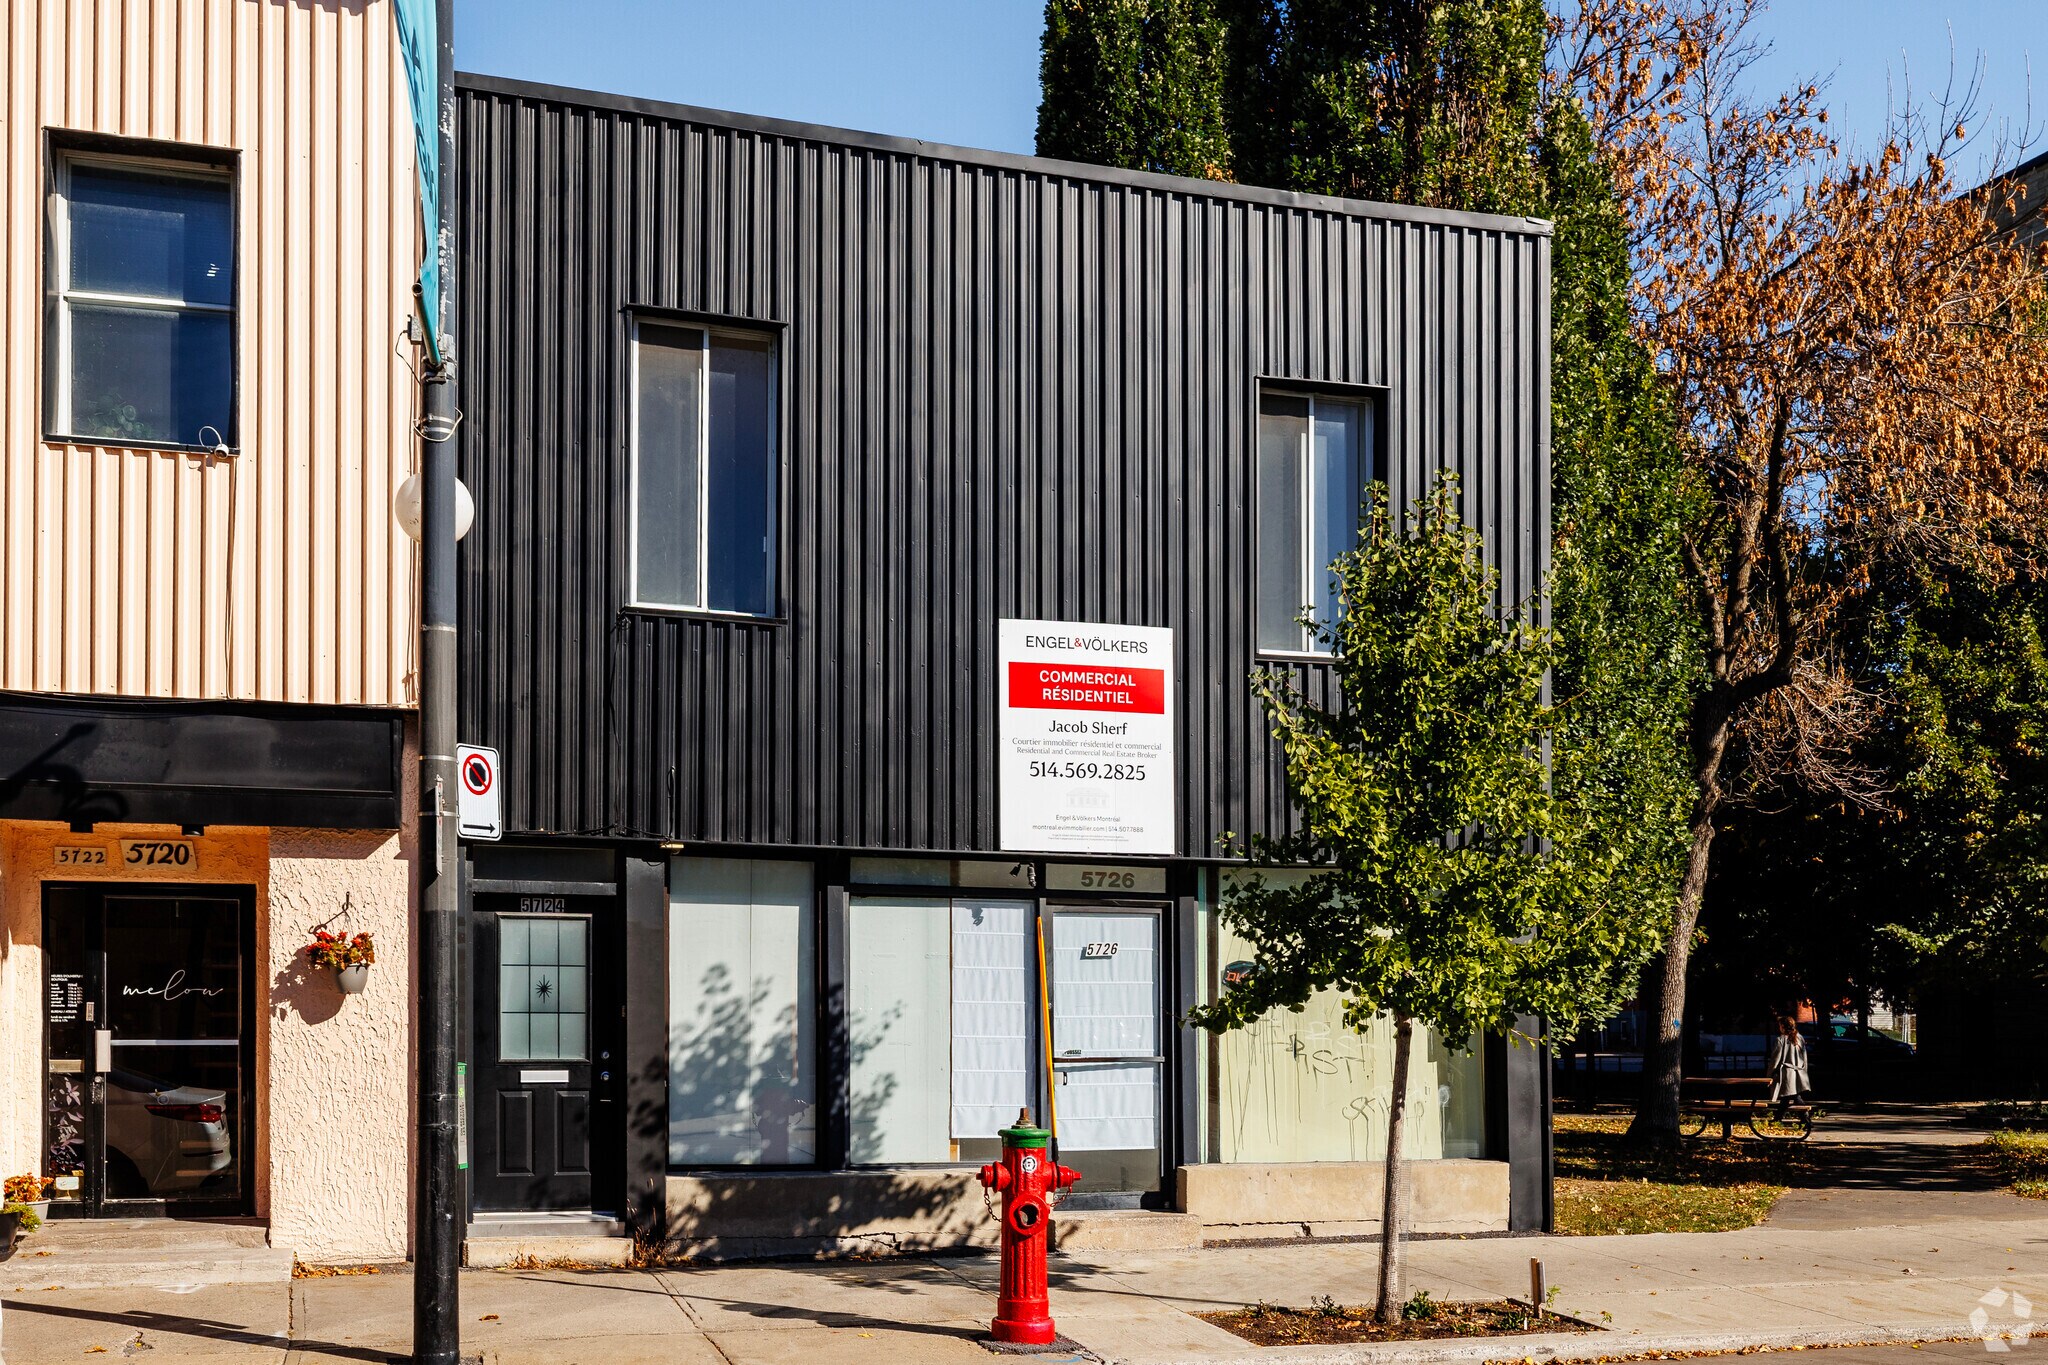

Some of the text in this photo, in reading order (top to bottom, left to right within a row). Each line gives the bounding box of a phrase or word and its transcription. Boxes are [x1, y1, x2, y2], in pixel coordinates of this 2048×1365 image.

[1039, 670, 1136, 687] COMMERCIAL
[1042, 685, 1133, 704] RÉSIDENTIEL
[1048, 720, 1128, 735] Jacob Sherf
[1012, 737, 1041, 746] Courtier
[1043, 738, 1079, 748] immobilier
[1080, 740, 1114, 749] résidentiel
[1124, 743, 1162, 751] commercial
[1016, 746, 1051, 755] Residential
[1064, 748, 1101, 757] Commercial
[1116, 750, 1136, 758] Estate
[1137, 751, 1158, 759] Broker
[1029, 761, 1146, 781] 514.569.2825
[59, 850, 105, 864] 5722
[126, 843, 190, 866] 5720
[1081, 871, 1135, 889] 5726
[521, 898, 564, 912] 5724
[1086, 943, 1119, 956] 5726
